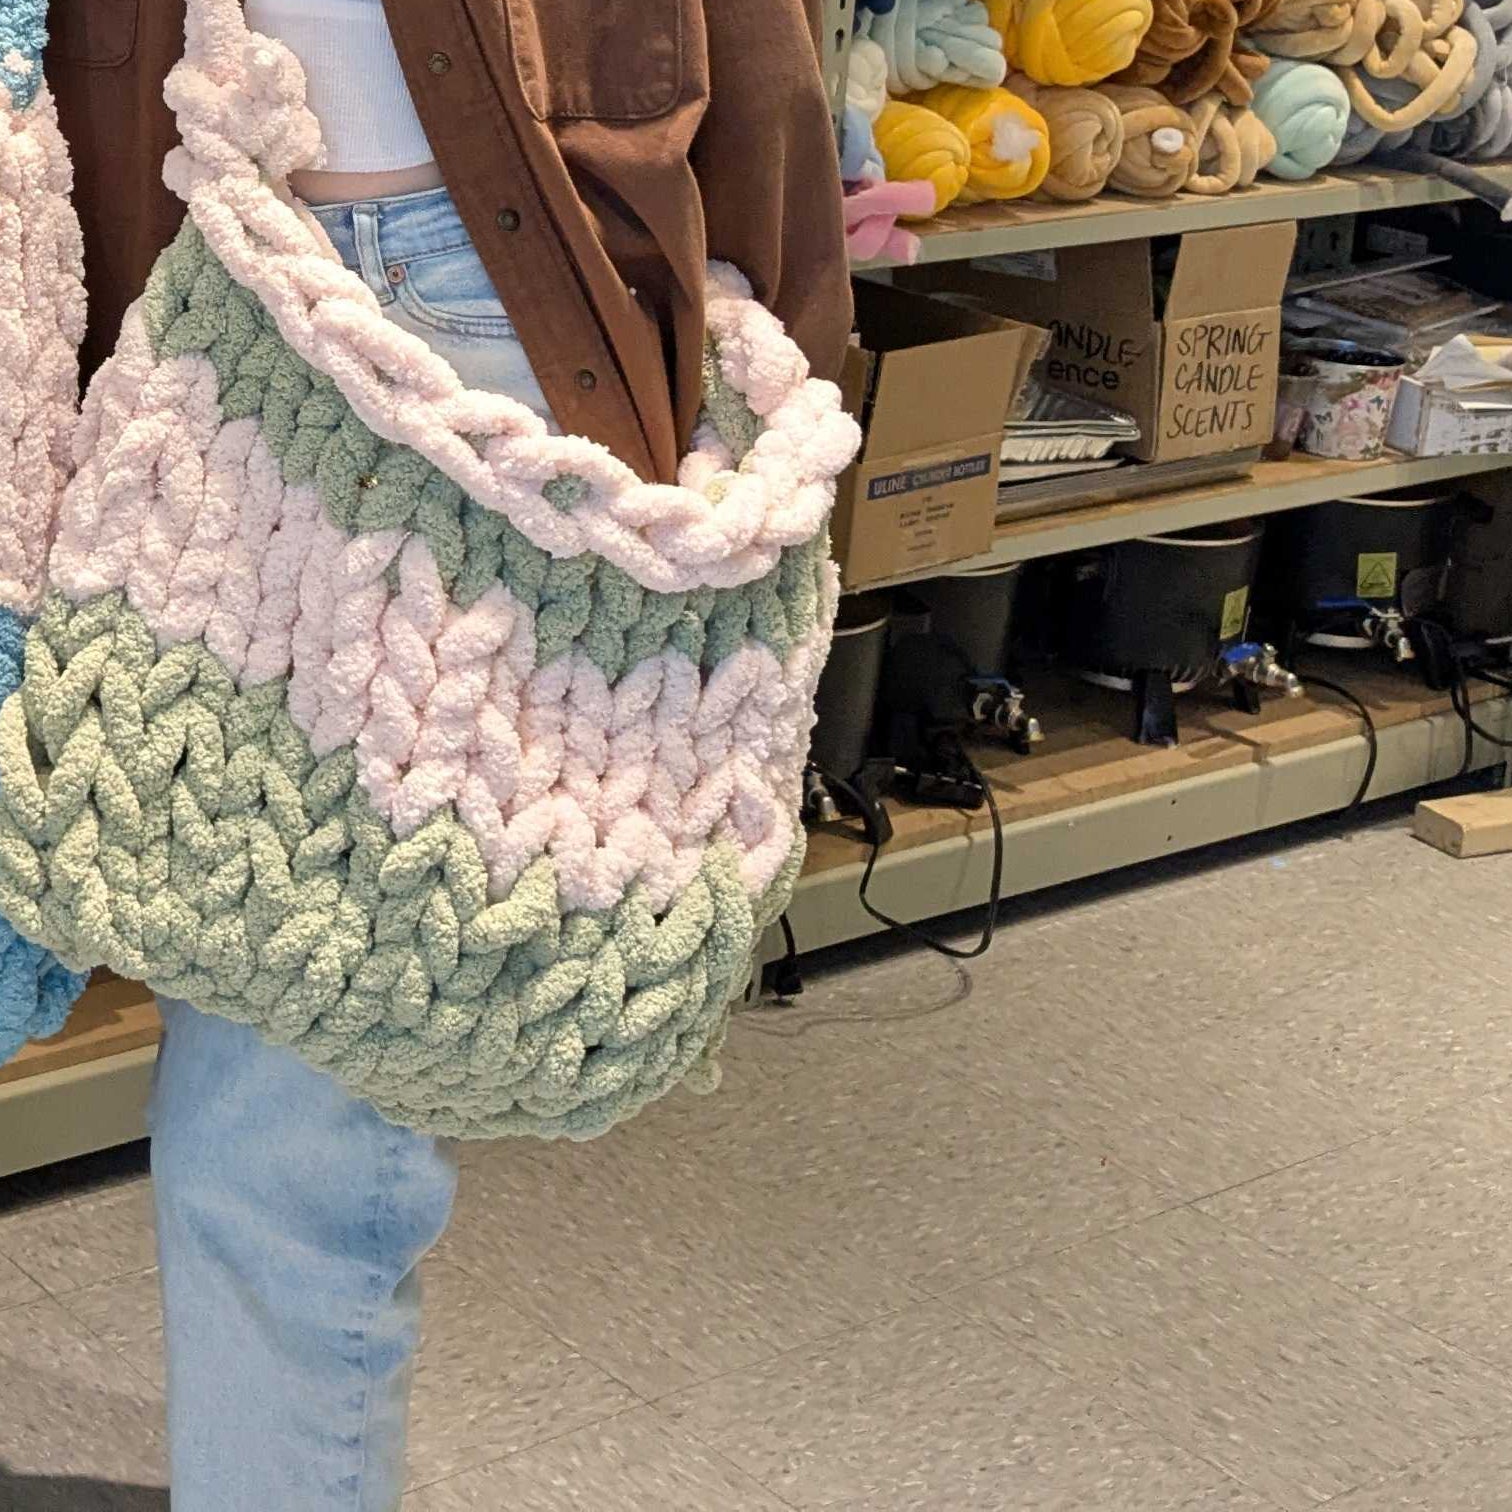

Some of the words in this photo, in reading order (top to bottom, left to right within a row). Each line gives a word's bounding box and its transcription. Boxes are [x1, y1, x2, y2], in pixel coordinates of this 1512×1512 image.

[1048, 319, 1141, 368] ANDLE
[1177, 322, 1272, 360] SPRING
[1047, 358, 1120, 389] ence
[1174, 360, 1264, 395] CANDLE
[1166, 399, 1256, 439] SCENTS
